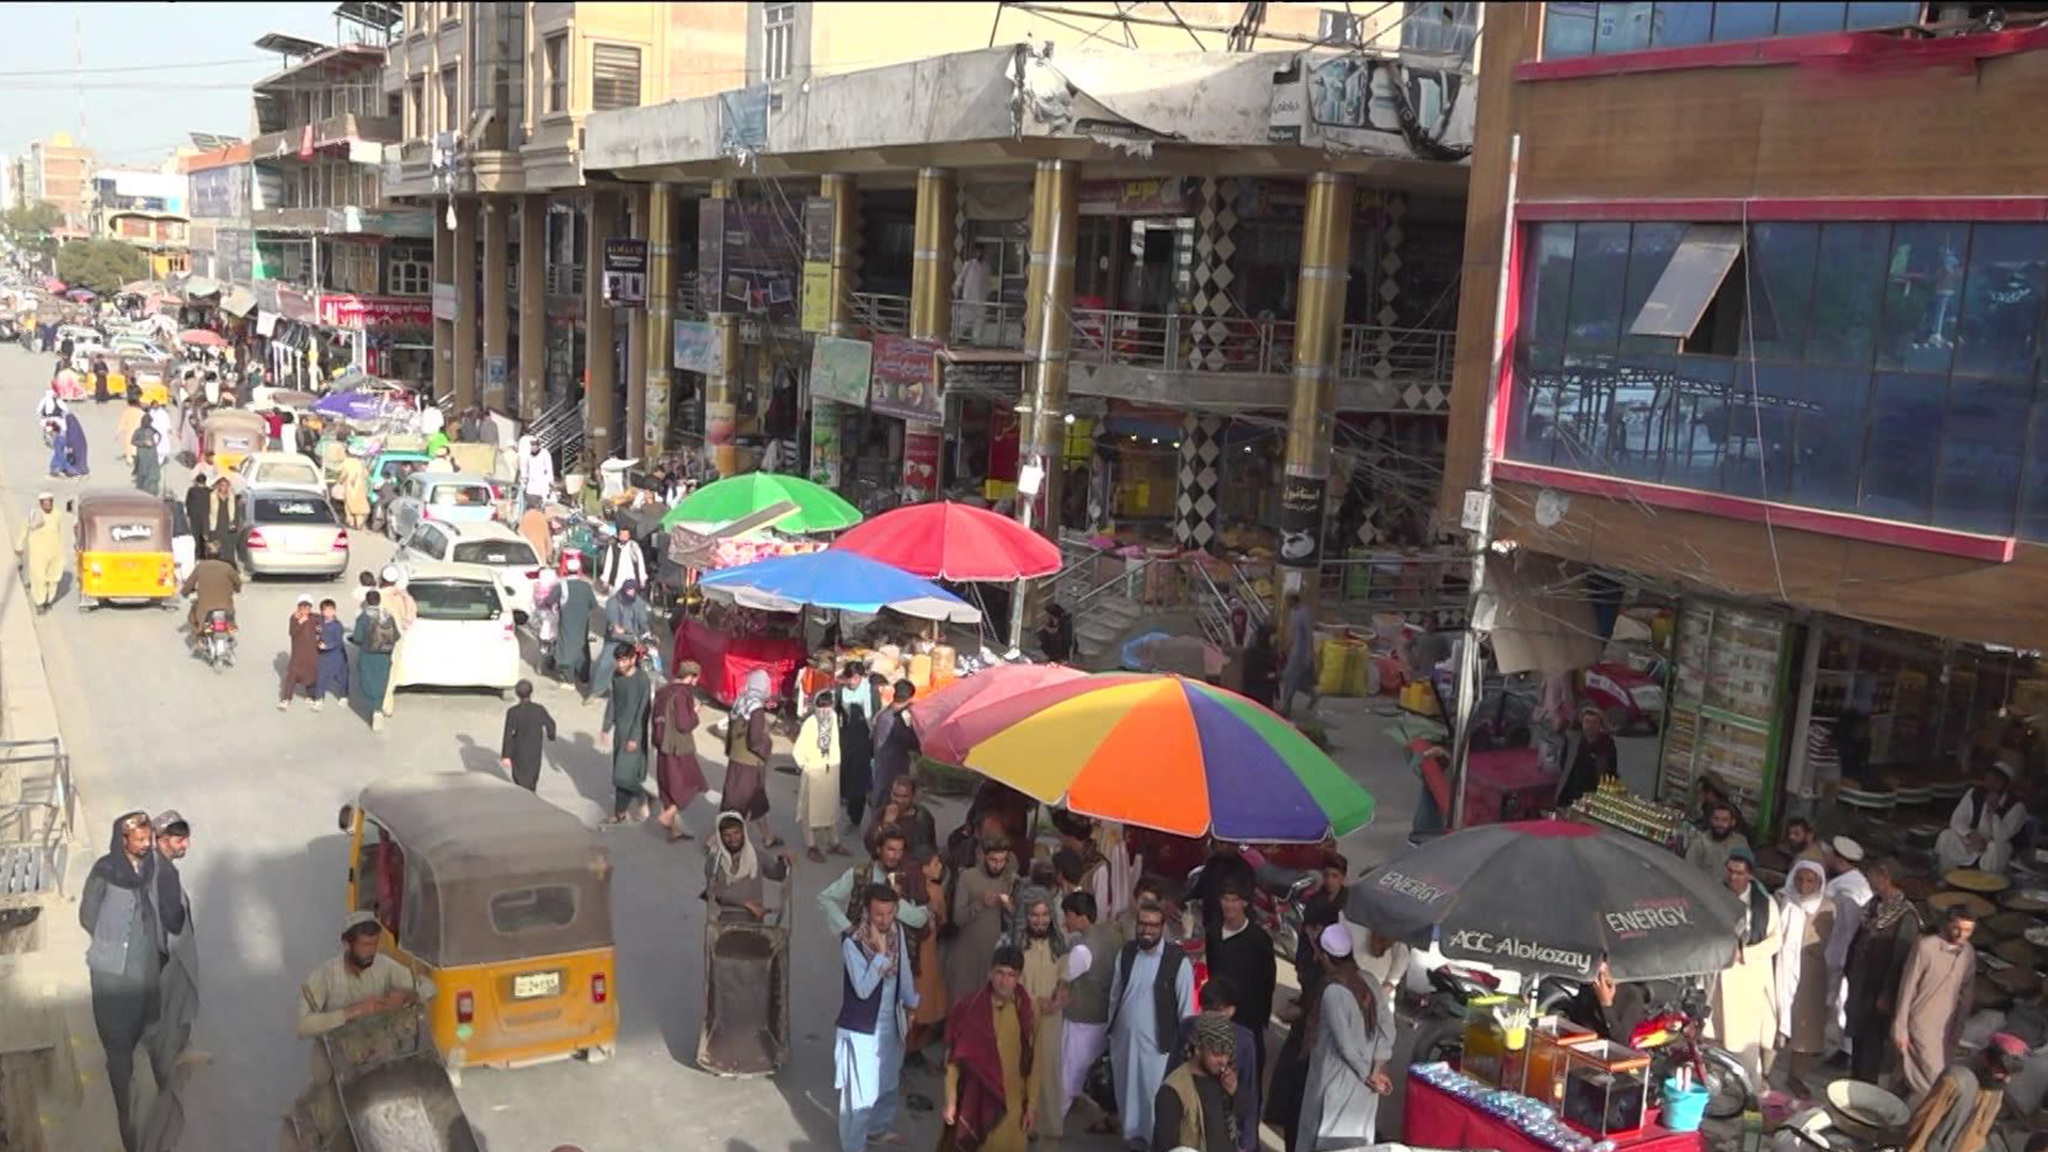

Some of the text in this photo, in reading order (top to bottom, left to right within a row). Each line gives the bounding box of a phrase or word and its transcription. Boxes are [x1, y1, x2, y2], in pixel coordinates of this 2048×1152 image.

[1379, 871, 1446, 904] ENERGY
[1605, 905, 1688, 932] ENERGY
[1450, 930, 1591, 976] ACC Alokozay
